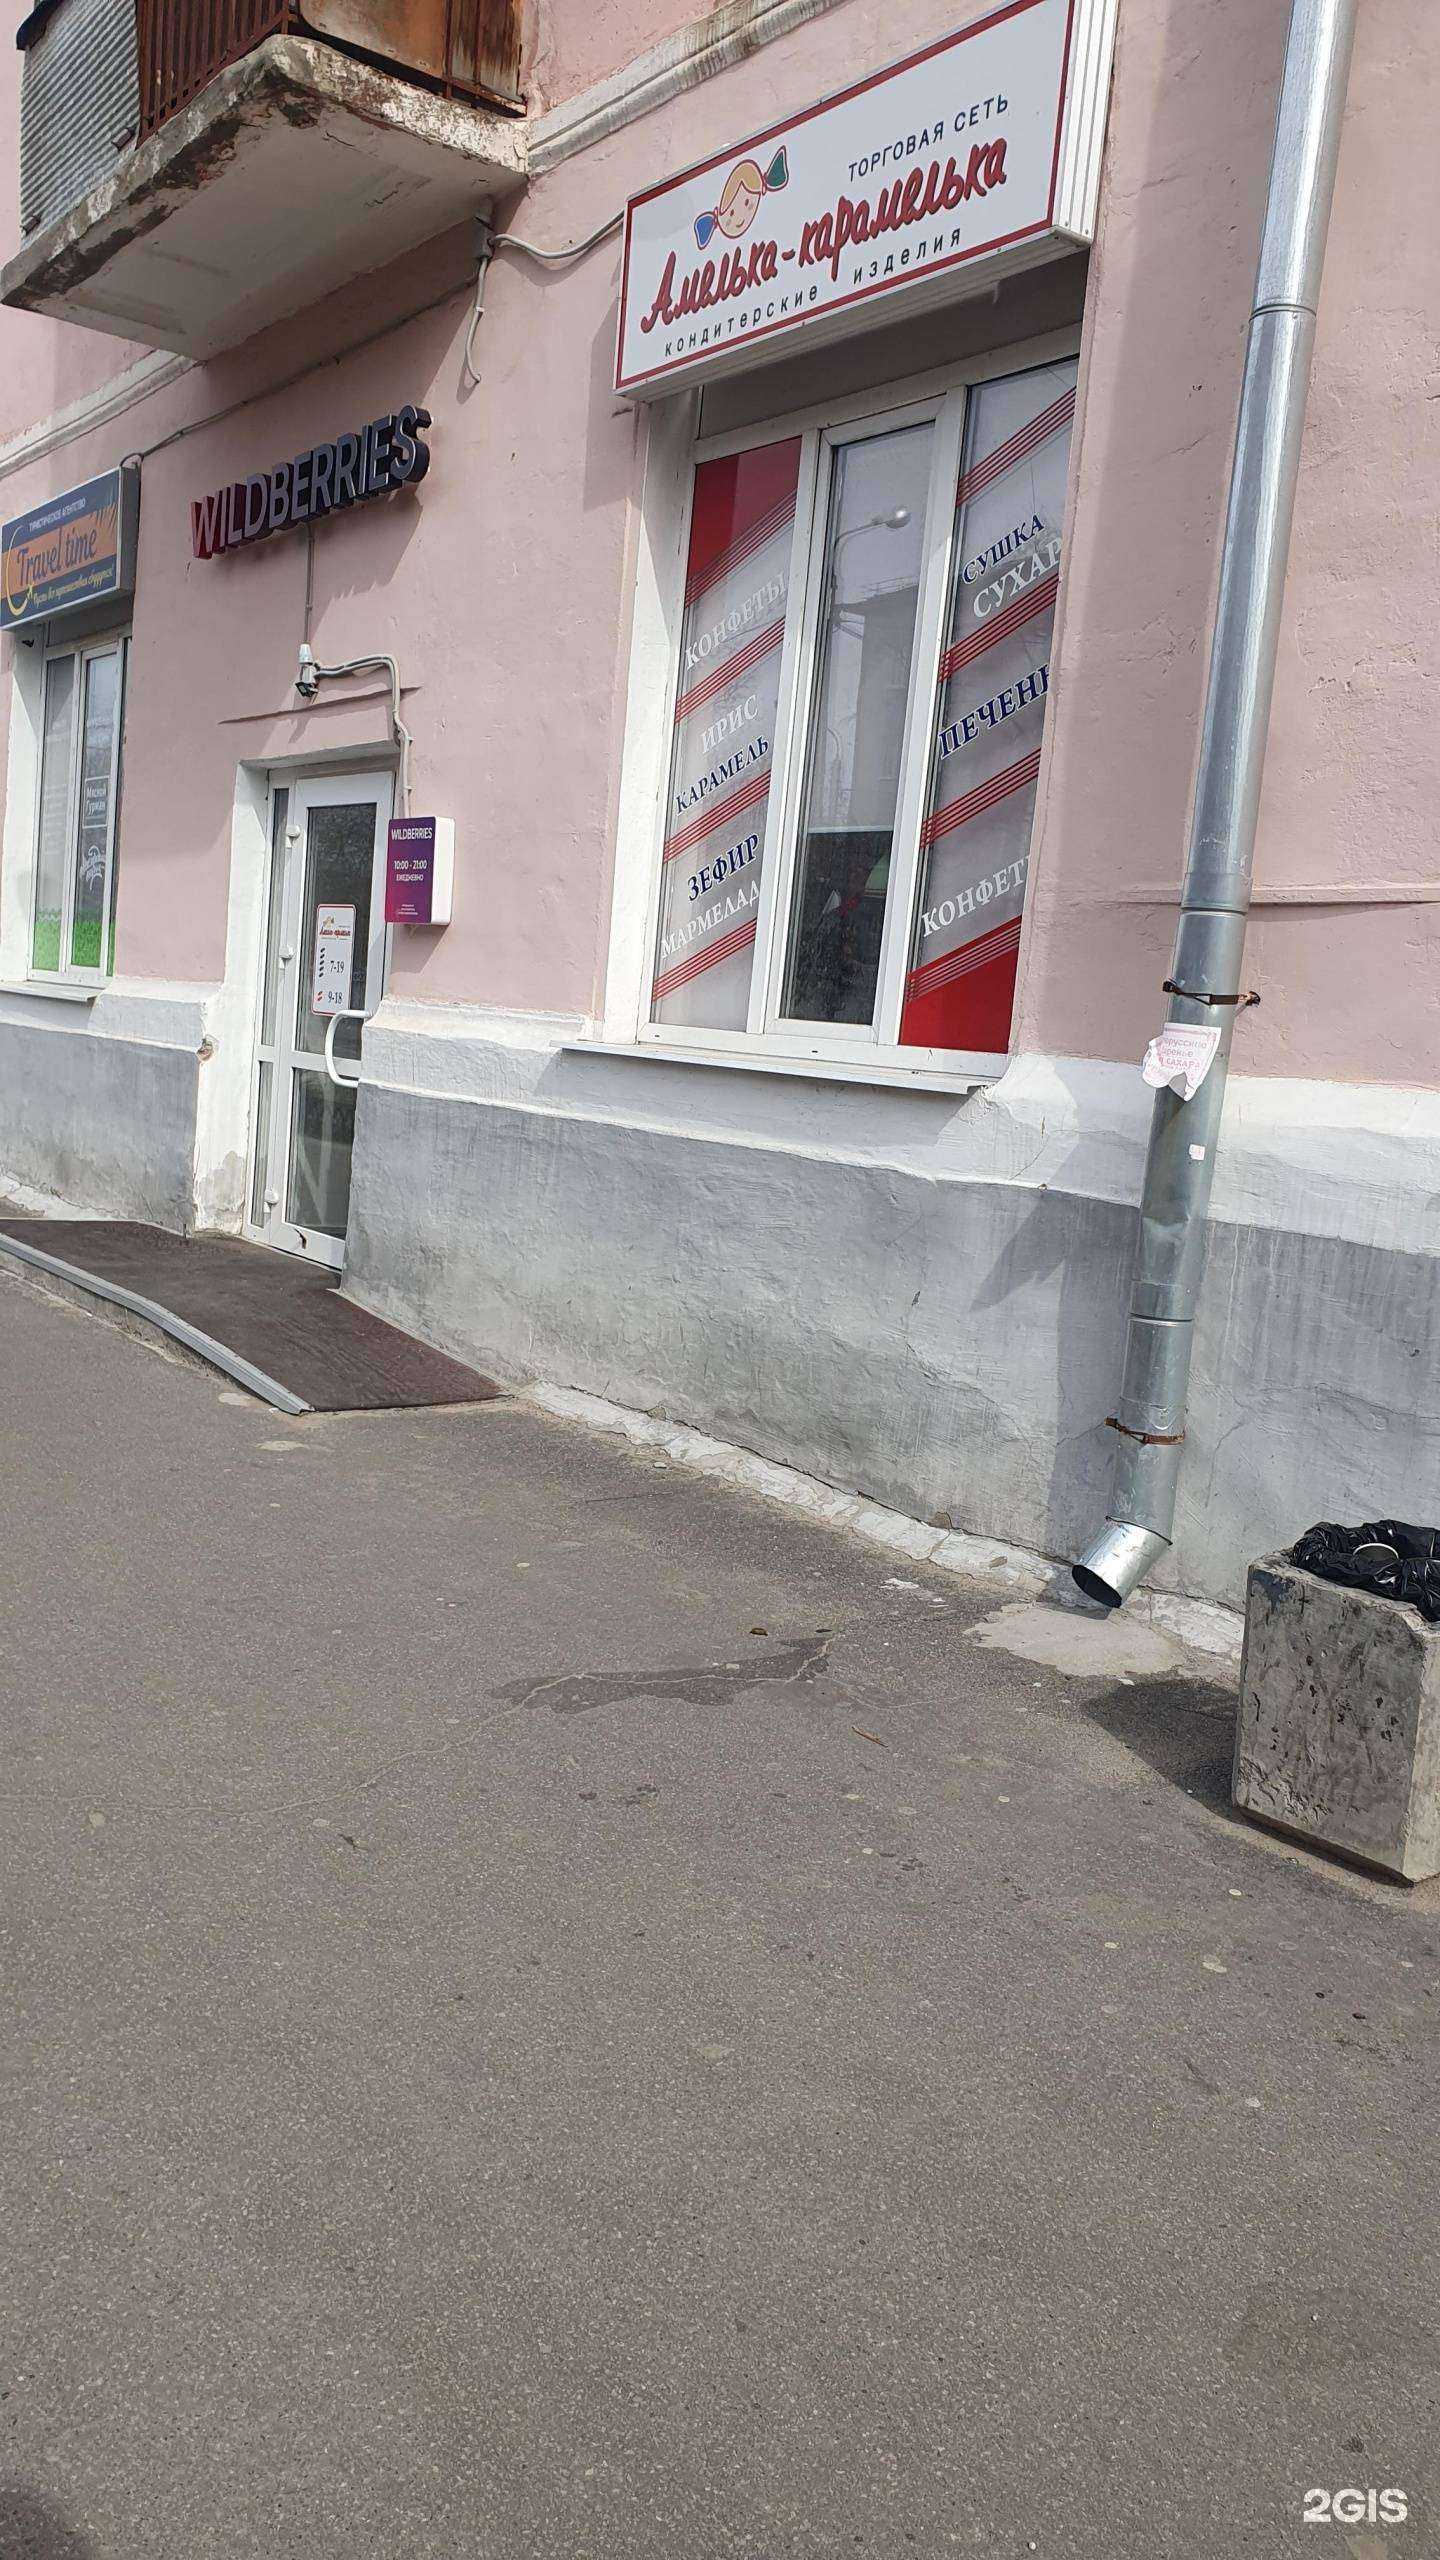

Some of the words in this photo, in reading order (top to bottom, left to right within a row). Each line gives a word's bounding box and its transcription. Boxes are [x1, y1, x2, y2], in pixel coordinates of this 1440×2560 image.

[848, 123, 944, 182] ТОРГОВАЯ
[953, 94, 1009, 134] СЕТЬ
[640, 137, 1007, 333] Амелька-карамелька
[665, 285, 818, 357] кондитерские
[852, 228, 962, 284] изделия
[190, 405, 431, 559] WILDBERRIES
[17, 527, 63, 587] Travel
[64, 527, 98, 569] time
[962, 513, 1045, 584] СУШКА
[685, 574, 786, 671] КОНФЕТЫ
[700, 695, 759, 755] ИРИС
[675, 736, 769, 816] КАРАМЕЛЬ
[391, 827, 433, 840] WILDBERRIES
[393, 860, 409, 870] 10:00
[413, 860, 428, 870] 21:00
[687, 834, 760, 901] ЗЕФИР
[660, 880, 760, 958] МАРМЕЛАД
[921, 855, 1030, 938] КОНФЕТ
[328, 991, 343, 1004] 9-18
[330, 960, 345, 973] 7-19
